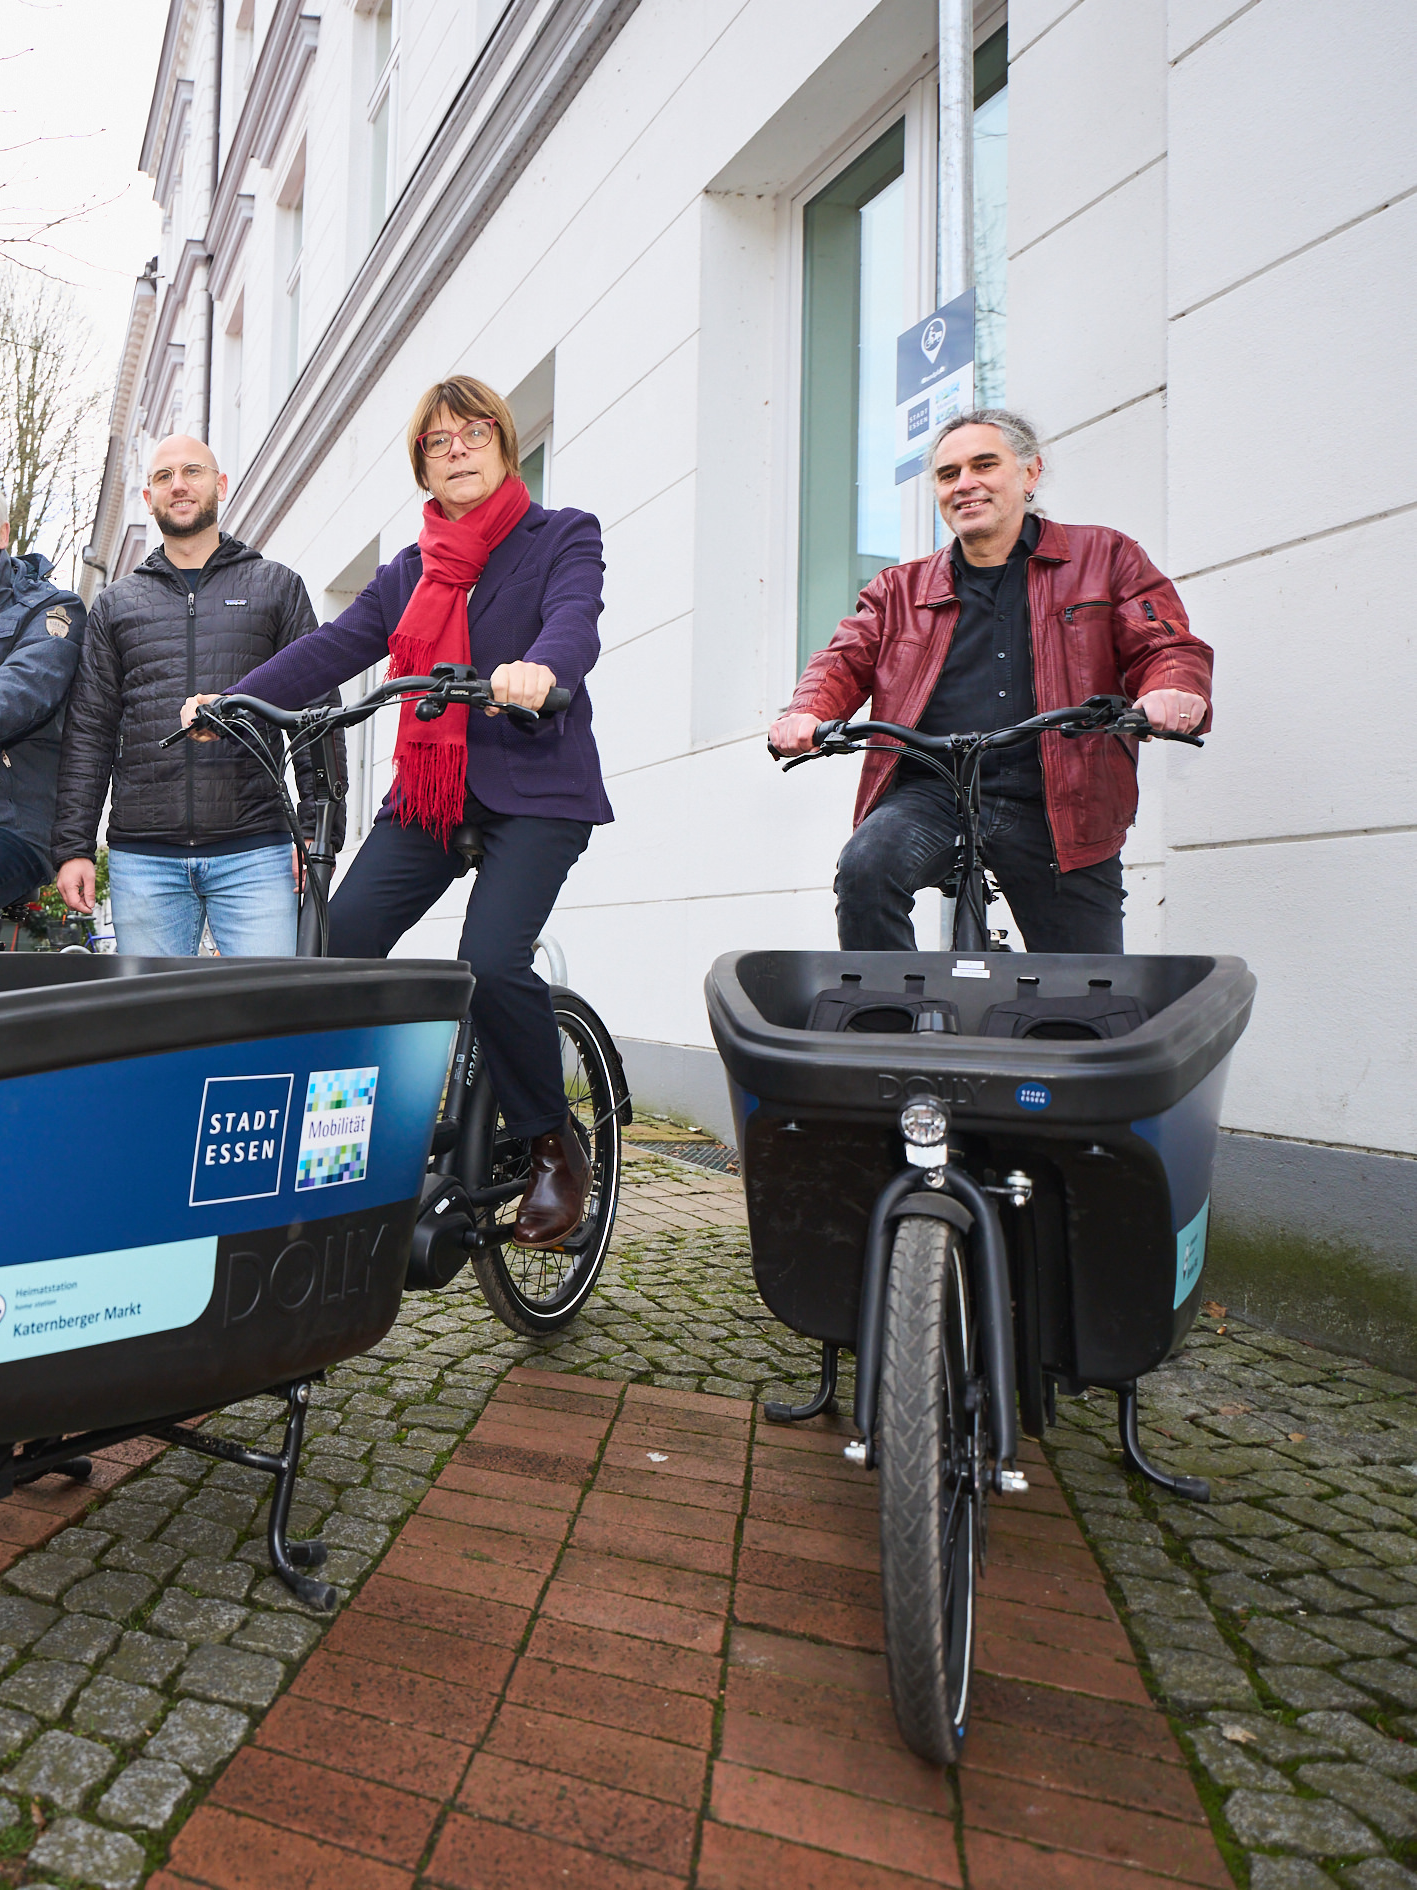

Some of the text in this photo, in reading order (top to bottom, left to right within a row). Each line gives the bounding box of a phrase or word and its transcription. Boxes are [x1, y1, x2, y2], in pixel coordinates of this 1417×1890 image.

[909, 407, 928, 424] STADT
[909, 416, 928, 431] ESSEN
[878, 1074, 987, 1105] DOLLY
[1020, 1095, 1046, 1104] ESSEN
[1021, 1089, 1046, 1098] STADT
[209, 1109, 279, 1135] STADT
[308, 1115, 366, 1139] Mobilität
[205, 1139, 275, 1166] ESSEN
[223, 1223, 389, 1329] DOLLY
[15, 1281, 78, 1298] Heimatstation
[12, 1303, 142, 1338] Katernberger Markt
